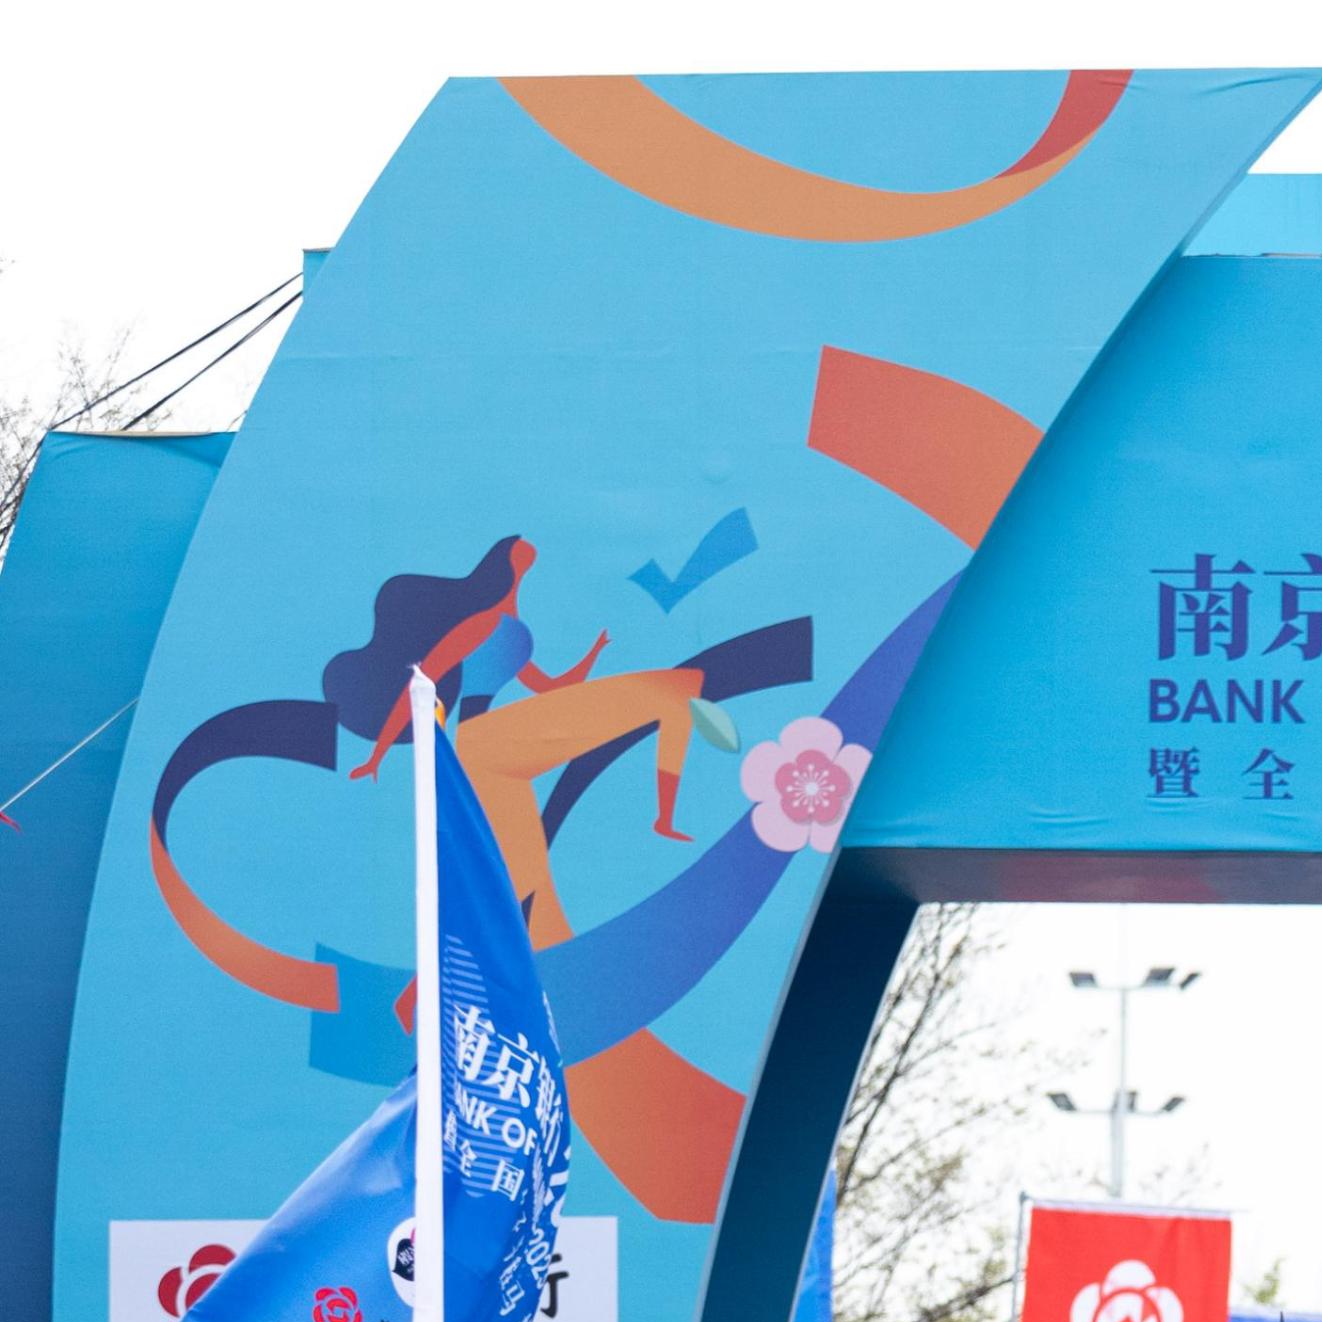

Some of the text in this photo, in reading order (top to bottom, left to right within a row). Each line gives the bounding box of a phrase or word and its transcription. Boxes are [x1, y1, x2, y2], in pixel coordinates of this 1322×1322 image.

[1148, 678, 1305, 725] BANK
[455, 1082, 538, 1158] ANK OF
